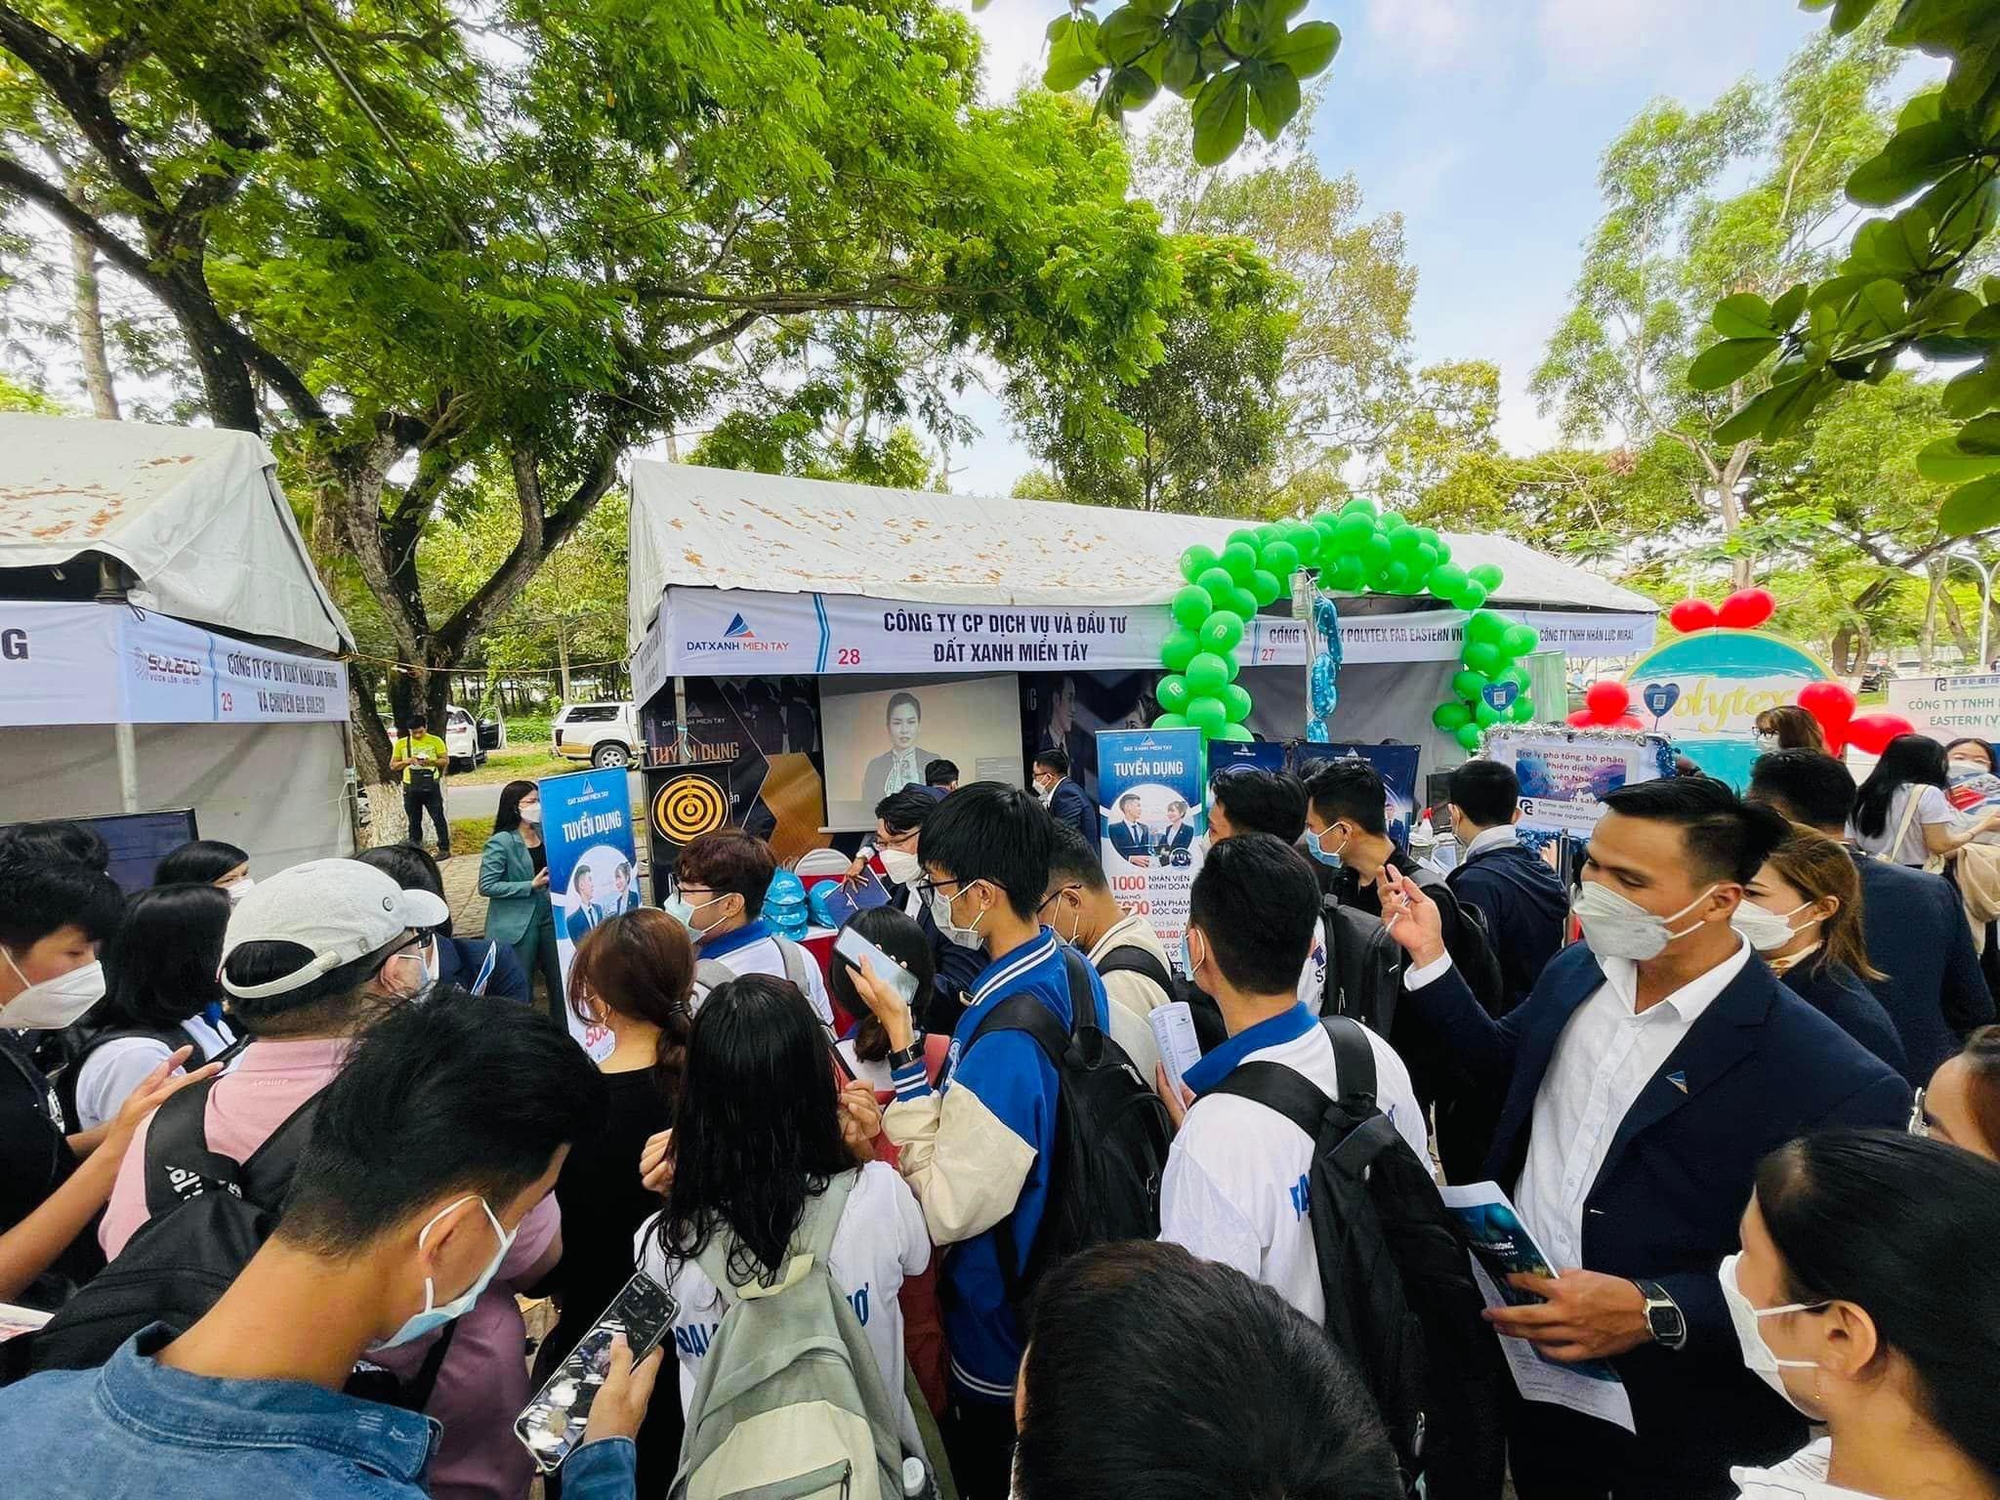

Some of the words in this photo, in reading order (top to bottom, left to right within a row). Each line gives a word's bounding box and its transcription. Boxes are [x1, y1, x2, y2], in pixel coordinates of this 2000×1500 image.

[884, 608, 932, 632] CÔNG
[937, 613, 956, 632] TY
[962, 614, 983, 633] CP
[989, 614, 1026, 637] DỊCH
[1030, 615, 1049, 638] VỤ
[1054, 612, 1073, 634] VÀ
[1077, 610, 1106, 634] ĐẦU
[1109, 615, 1127, 634] TƯ
[1, 628, 29, 661] G
[1347, 628, 1387, 643] POLYTEX
[1390, 628, 1408, 642] FAR
[1410, 627, 1449, 642] EASTERN
[1451, 627, 1463, 641] VN
[1560, 629, 1568, 642] TY
[1569, 629, 1585, 642] TNHH
[743, 642, 768, 651] MIEN
[771, 642, 789, 651] TAY
[934, 637, 965, 662] ĐẤT
[971, 643, 1013, 662] XANH
[1019, 637, 1057, 662] MIỀN
[1062, 640, 1088, 662] TÂY
[1261, 648, 1275, 661] 27
[227, 650, 251, 678] CÔNG
[253, 658, 261, 679] TY
[838, 648, 861, 665] 28
[221, 691, 234, 712] 29
[257, 687, 269, 712] VÀ
[1672, 673, 1794, 734] olytex
[1908, 697, 1940, 710] CÔNG
[1944, 699, 1958, 710] TY
[1961, 698, 1995, 709] TNHH
[1930, 714, 1981, 726] EASTERN
[1985, 714, 2000, 727] (V
[650, 744, 697, 766] TUYN
[1113, 756, 1150, 776] TUYỂN
[1153, 760, 1183, 778] DỤNG
[562, 811, 595, 843] TUYỂN
[595, 810, 622, 834] DỤNG
[1565, 812, 1598, 822] opportun
[1111, 875, 1146, 891] 1000
[1152, 908, 1170, 916] ĐỘC
